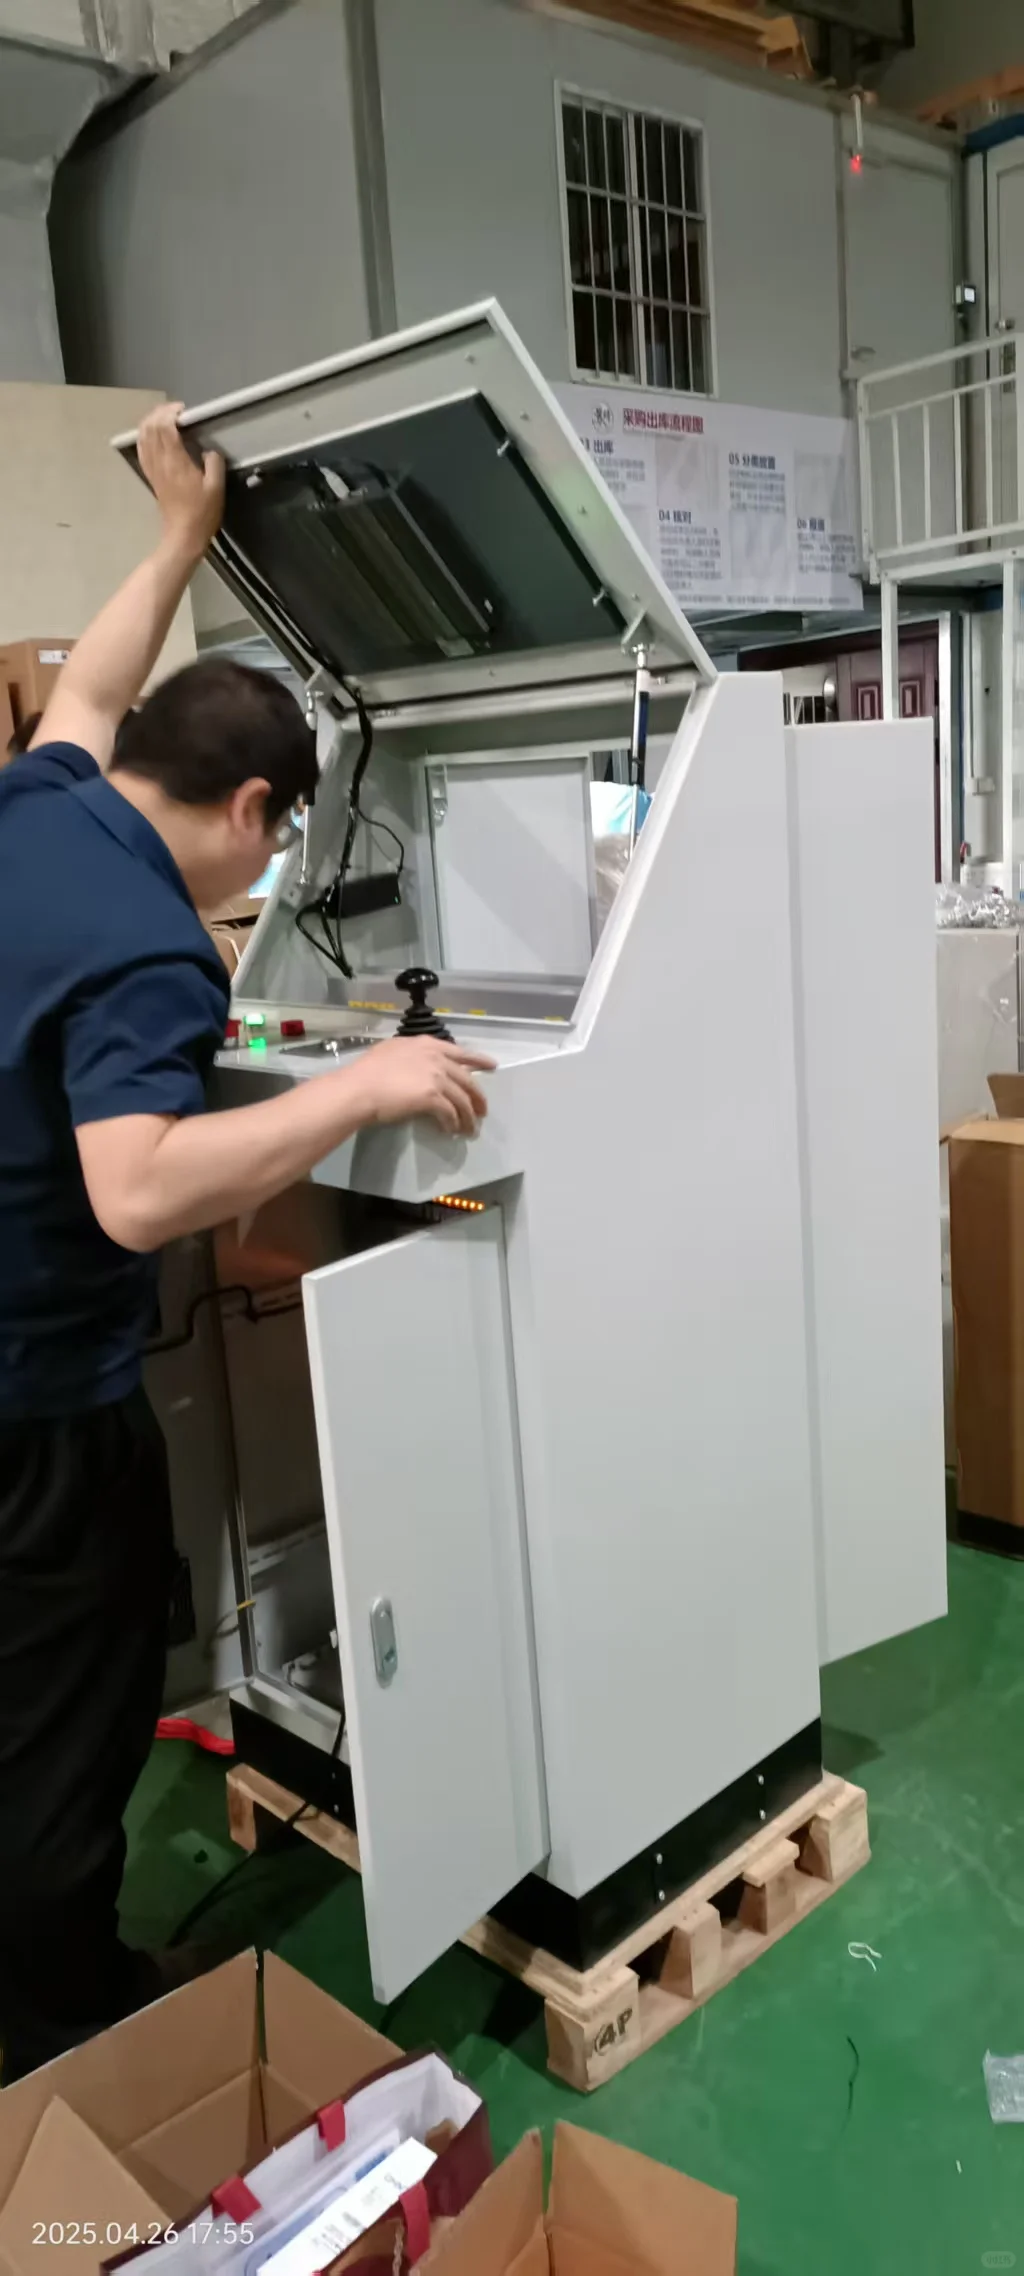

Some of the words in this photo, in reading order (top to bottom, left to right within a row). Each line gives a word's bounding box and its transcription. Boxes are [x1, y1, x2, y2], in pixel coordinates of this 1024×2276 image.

[623, 407, 704, 434] 采购出库流程图
[728, 451, 740, 466] 05
[658, 509, 670, 521] 04
